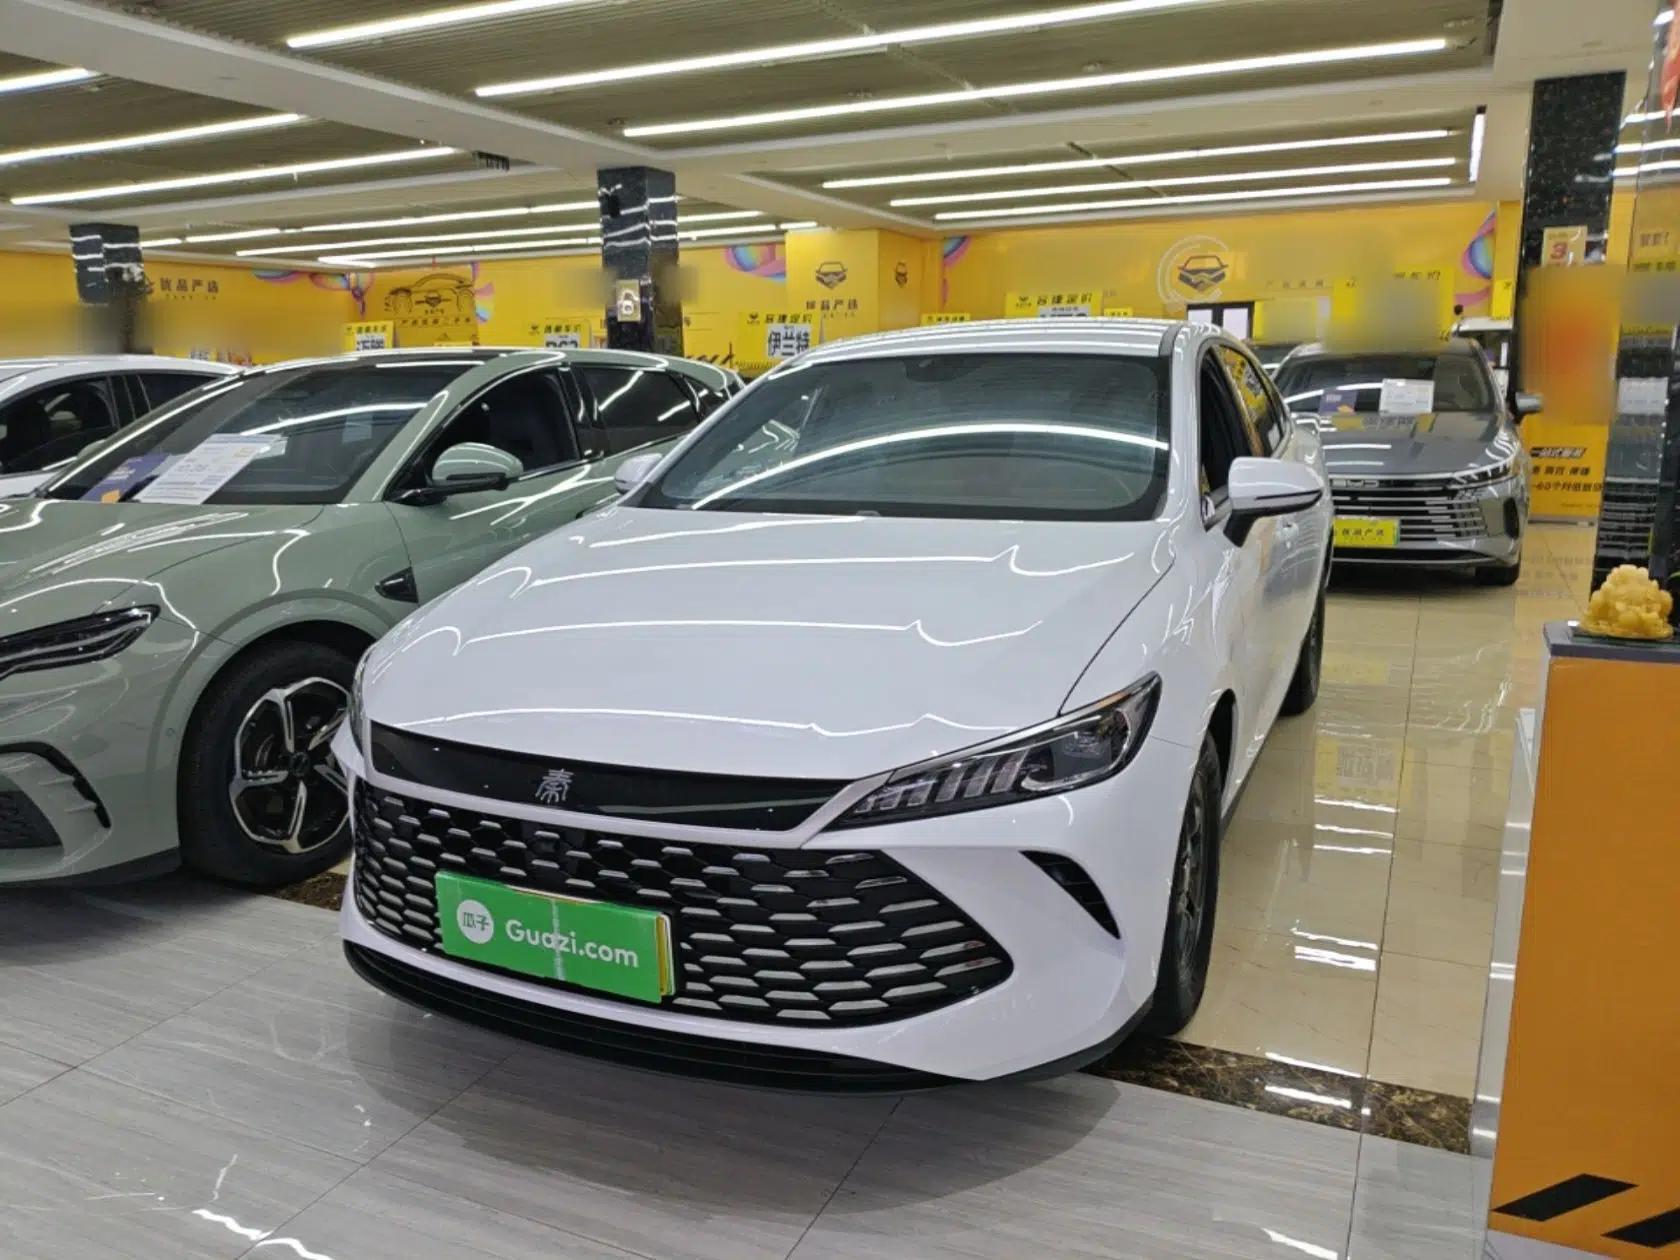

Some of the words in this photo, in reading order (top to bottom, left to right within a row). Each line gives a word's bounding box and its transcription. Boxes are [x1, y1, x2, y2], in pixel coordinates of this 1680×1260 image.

[768, 331, 809, 357] 伊兰特
[535, 768, 574, 803] 秦
[462, 911, 490, 931] 瓜子
[505, 919, 639, 968] Guazi.com
